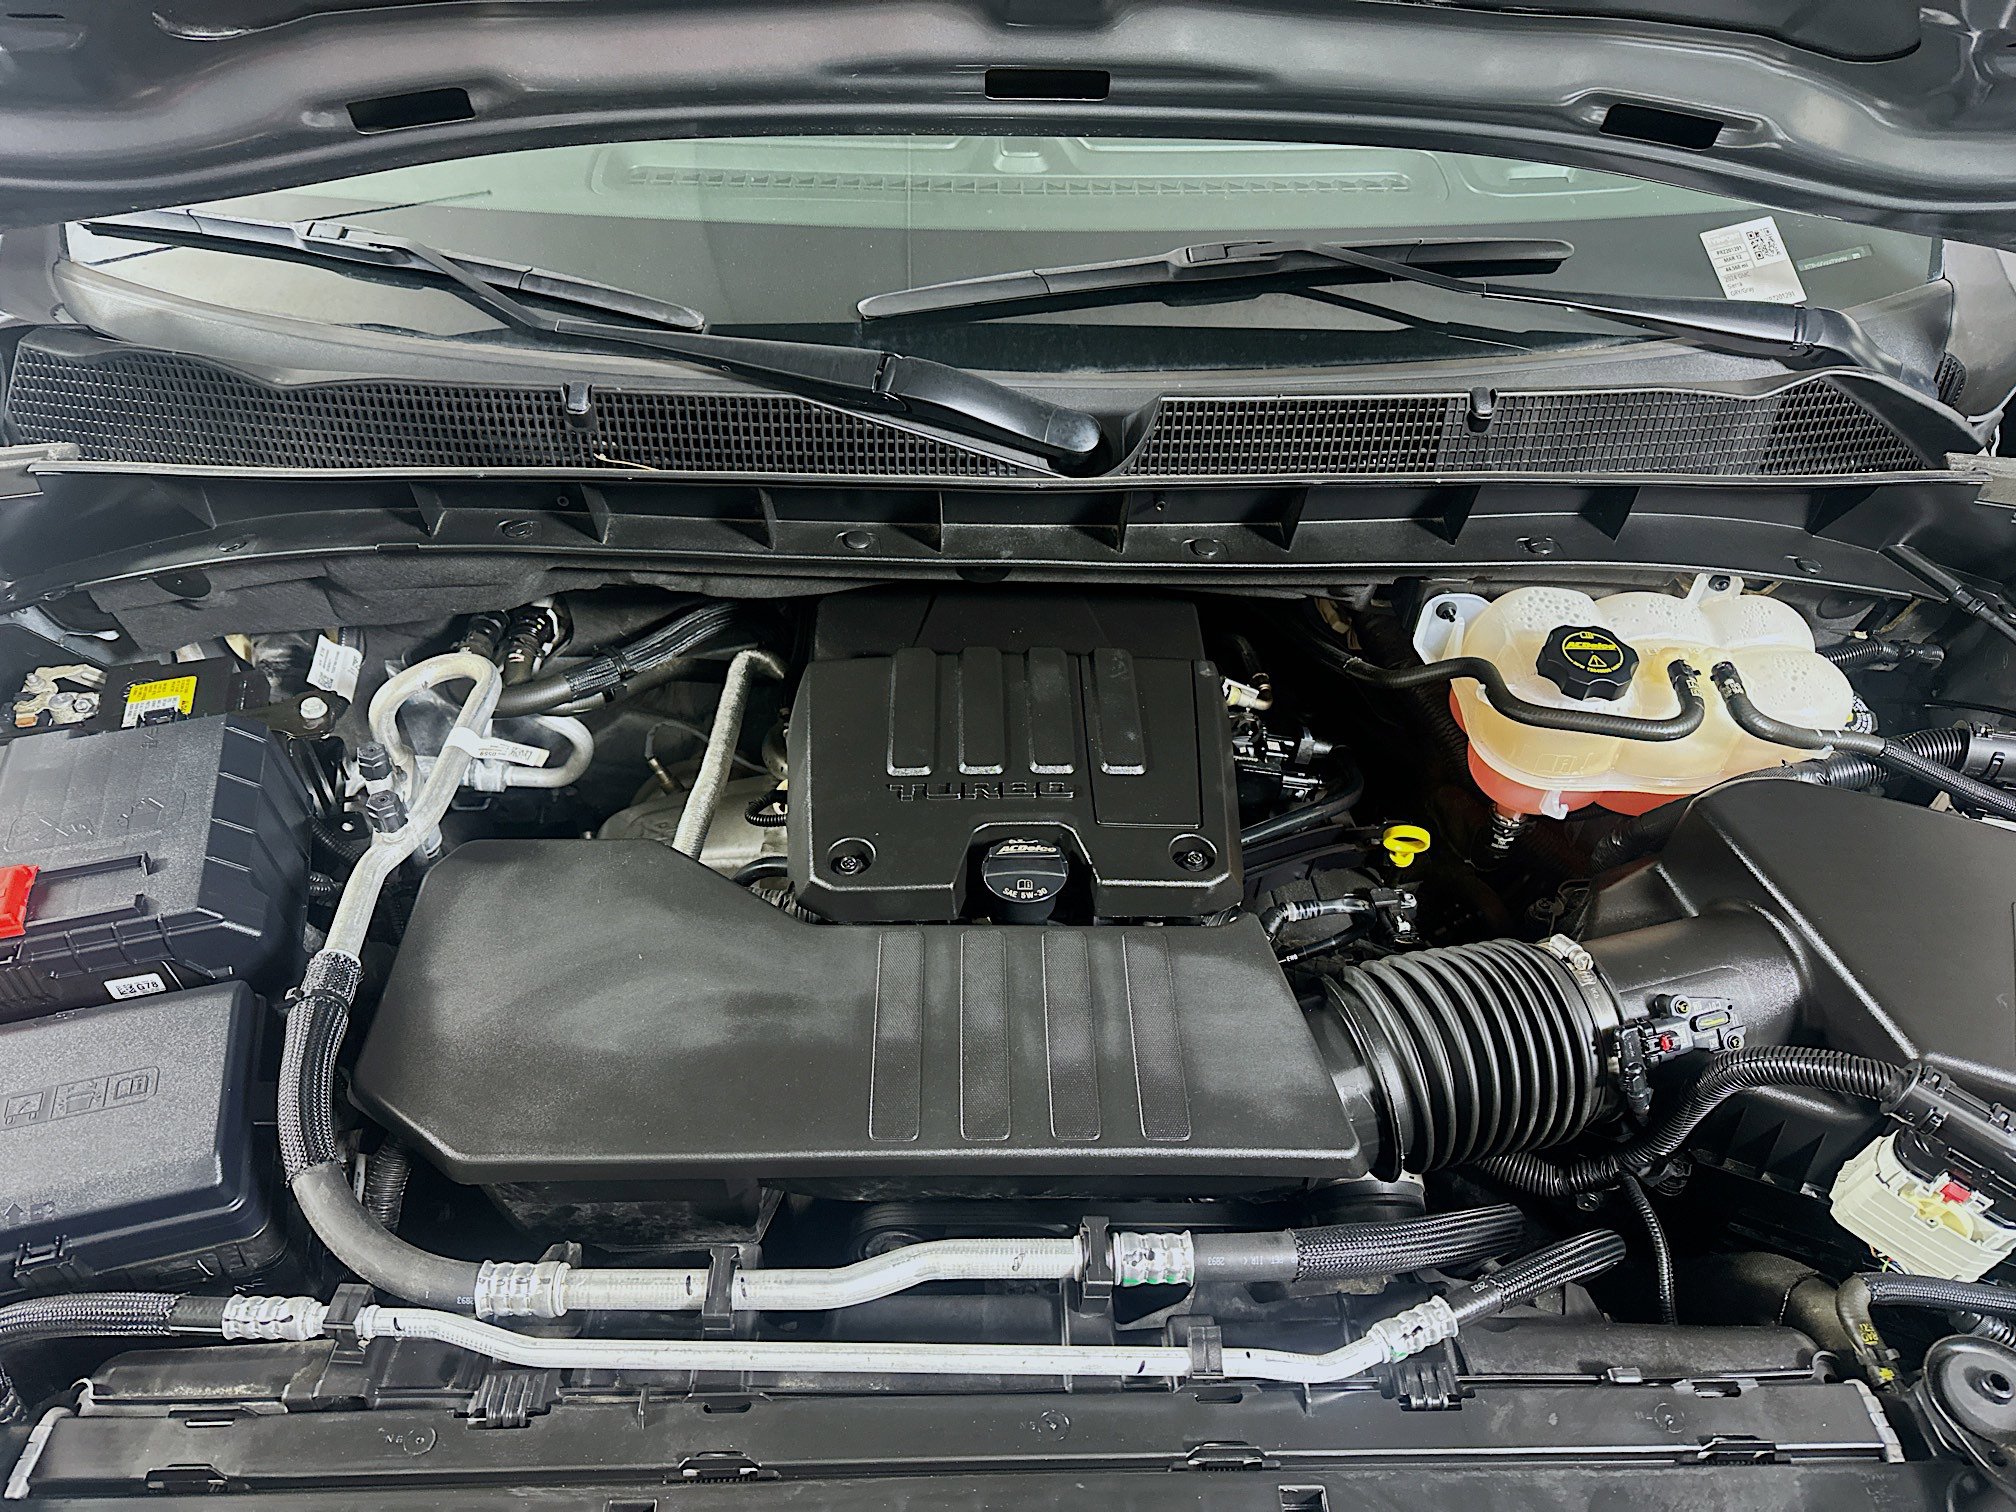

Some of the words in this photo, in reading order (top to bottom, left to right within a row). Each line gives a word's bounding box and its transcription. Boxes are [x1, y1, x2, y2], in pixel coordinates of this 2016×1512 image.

[1723, 255, 1737, 263] MAR
[1724, 273, 1738, 282] 2024
[886, 781, 1075, 802] TURBO
[996, 844, 1058, 855] ACDelco
[1002, 887, 1018, 899] SAE
[1021, 887, 1049, 899] 5W-30
